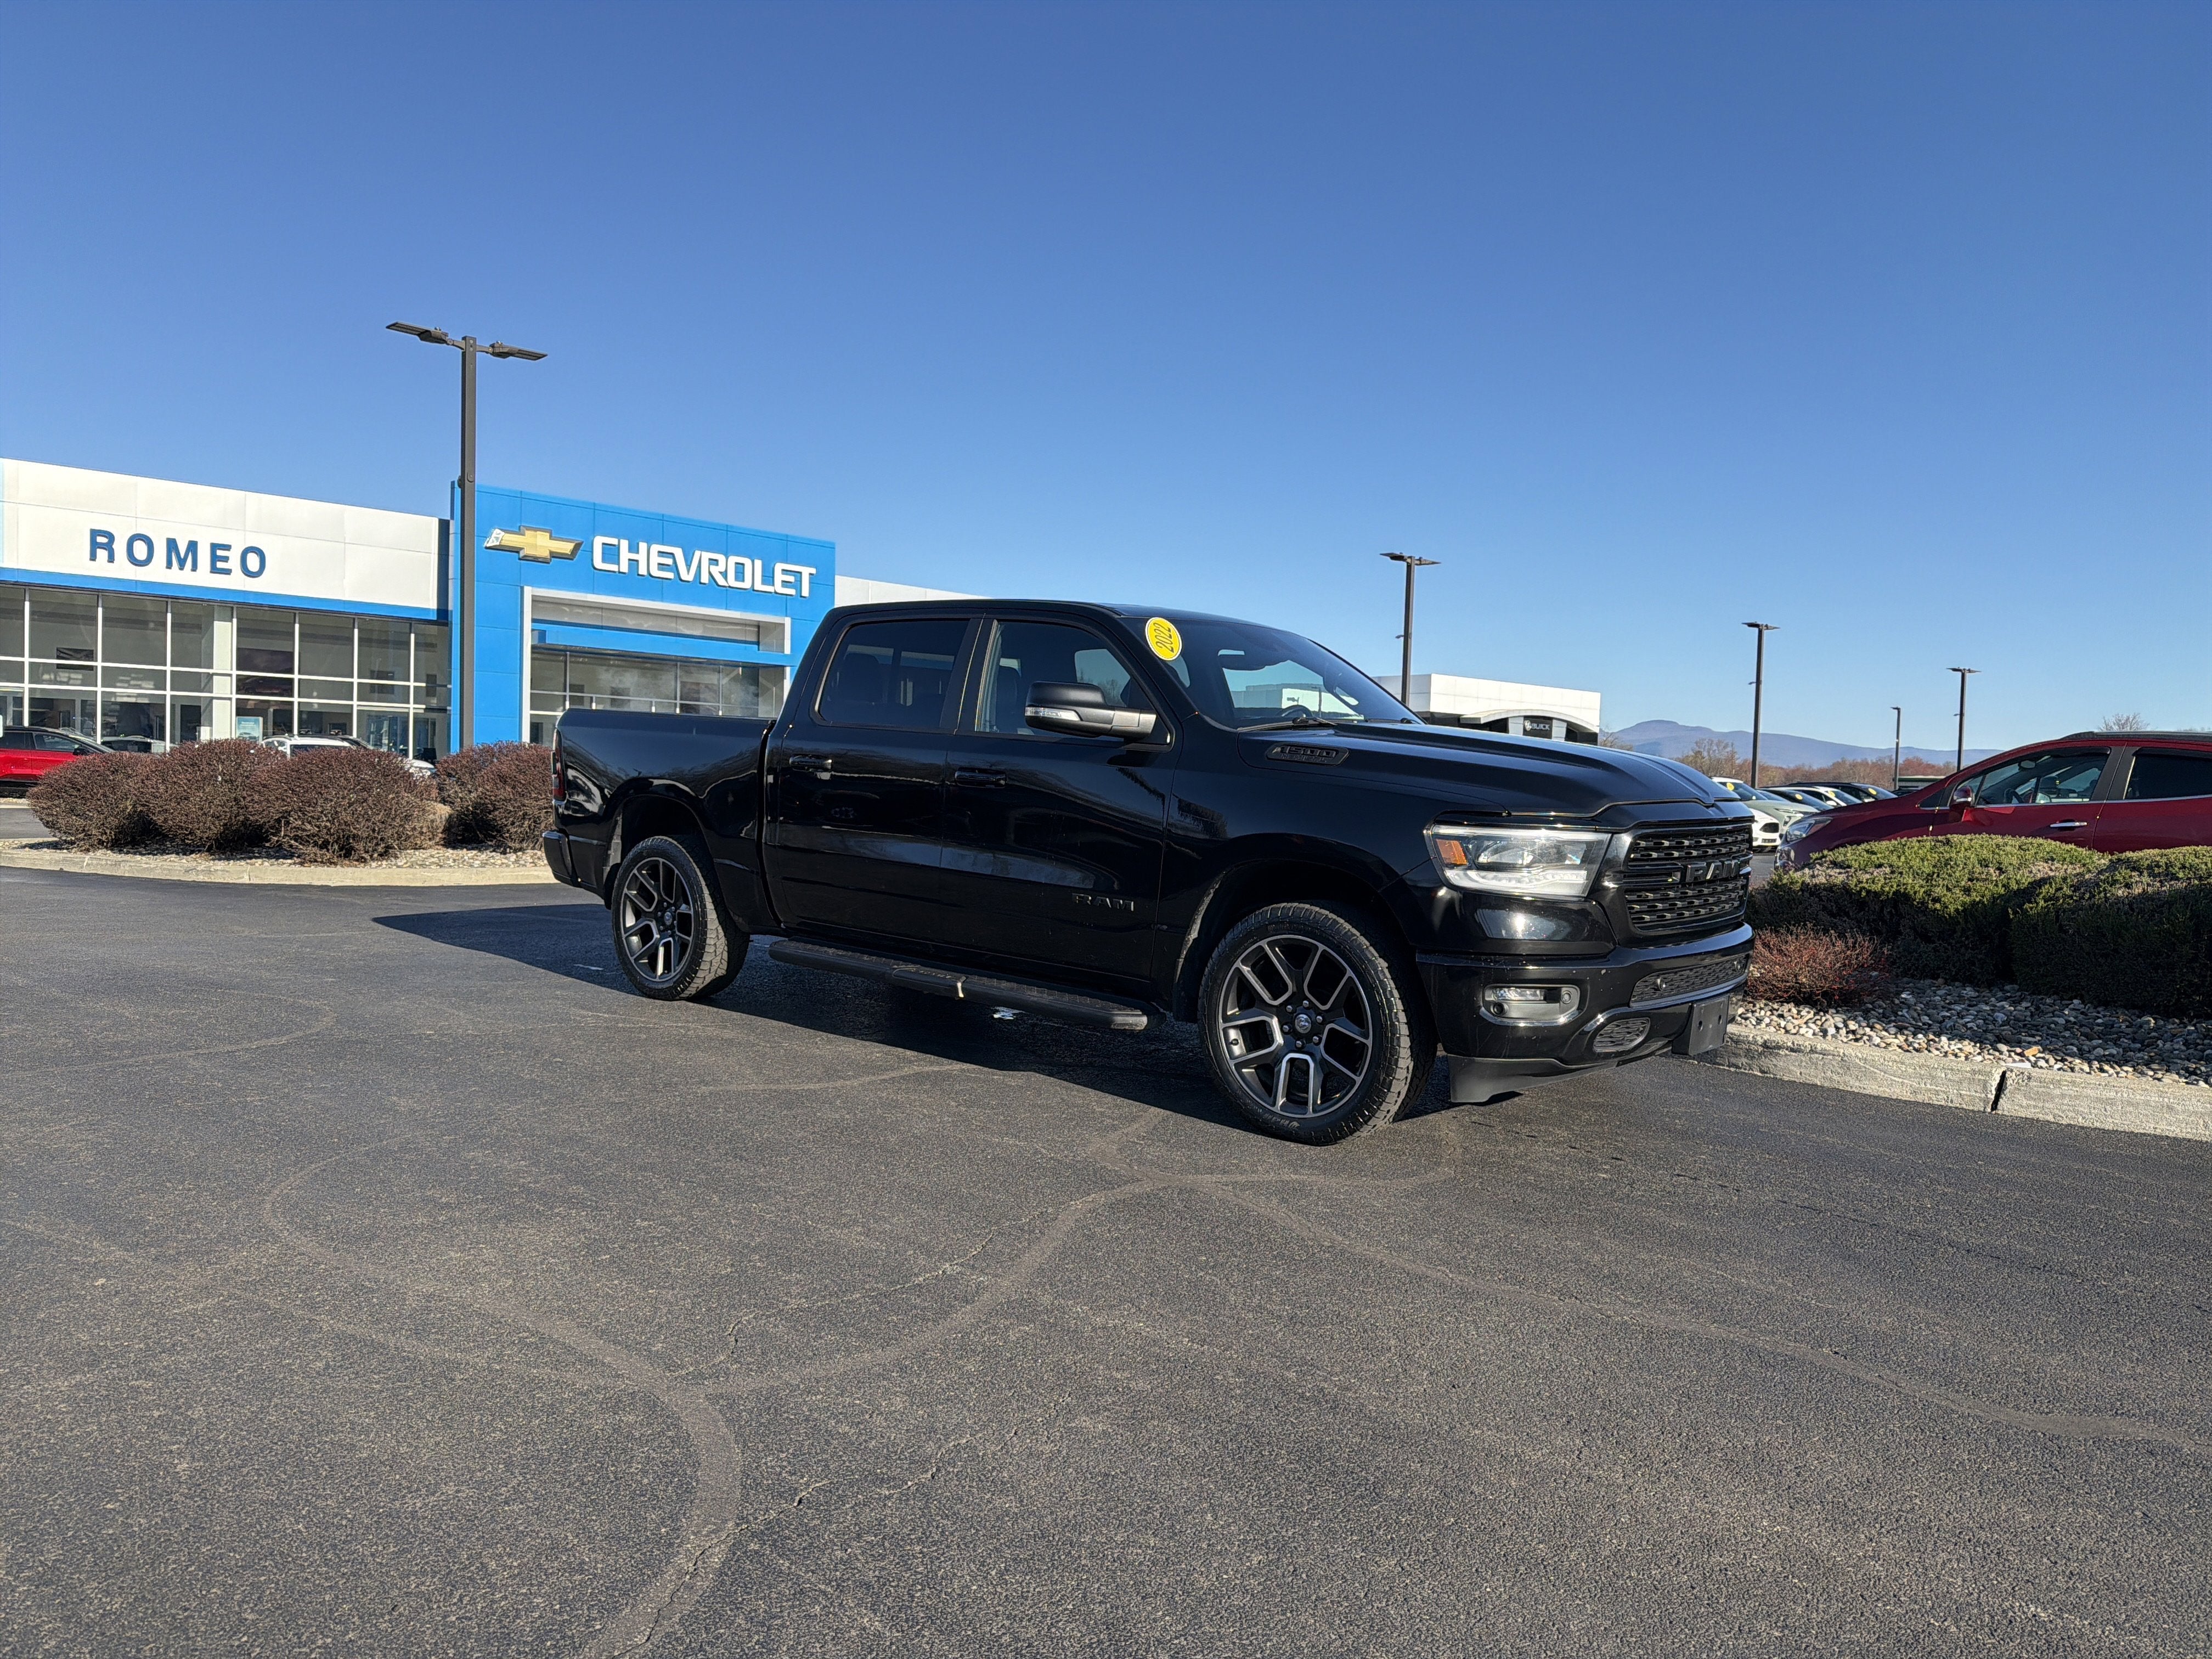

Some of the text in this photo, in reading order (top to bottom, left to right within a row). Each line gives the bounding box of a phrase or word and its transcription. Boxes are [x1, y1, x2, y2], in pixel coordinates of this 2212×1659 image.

[89, 528, 266, 578] ROMEO
[592, 535, 816, 597] CHEVROLET
[1153, 622, 1174, 653] 2022
[1272, 744, 1336, 758] 1500
[1686, 860, 1739, 882] RAM
[1071, 893, 1134, 912] RAM
